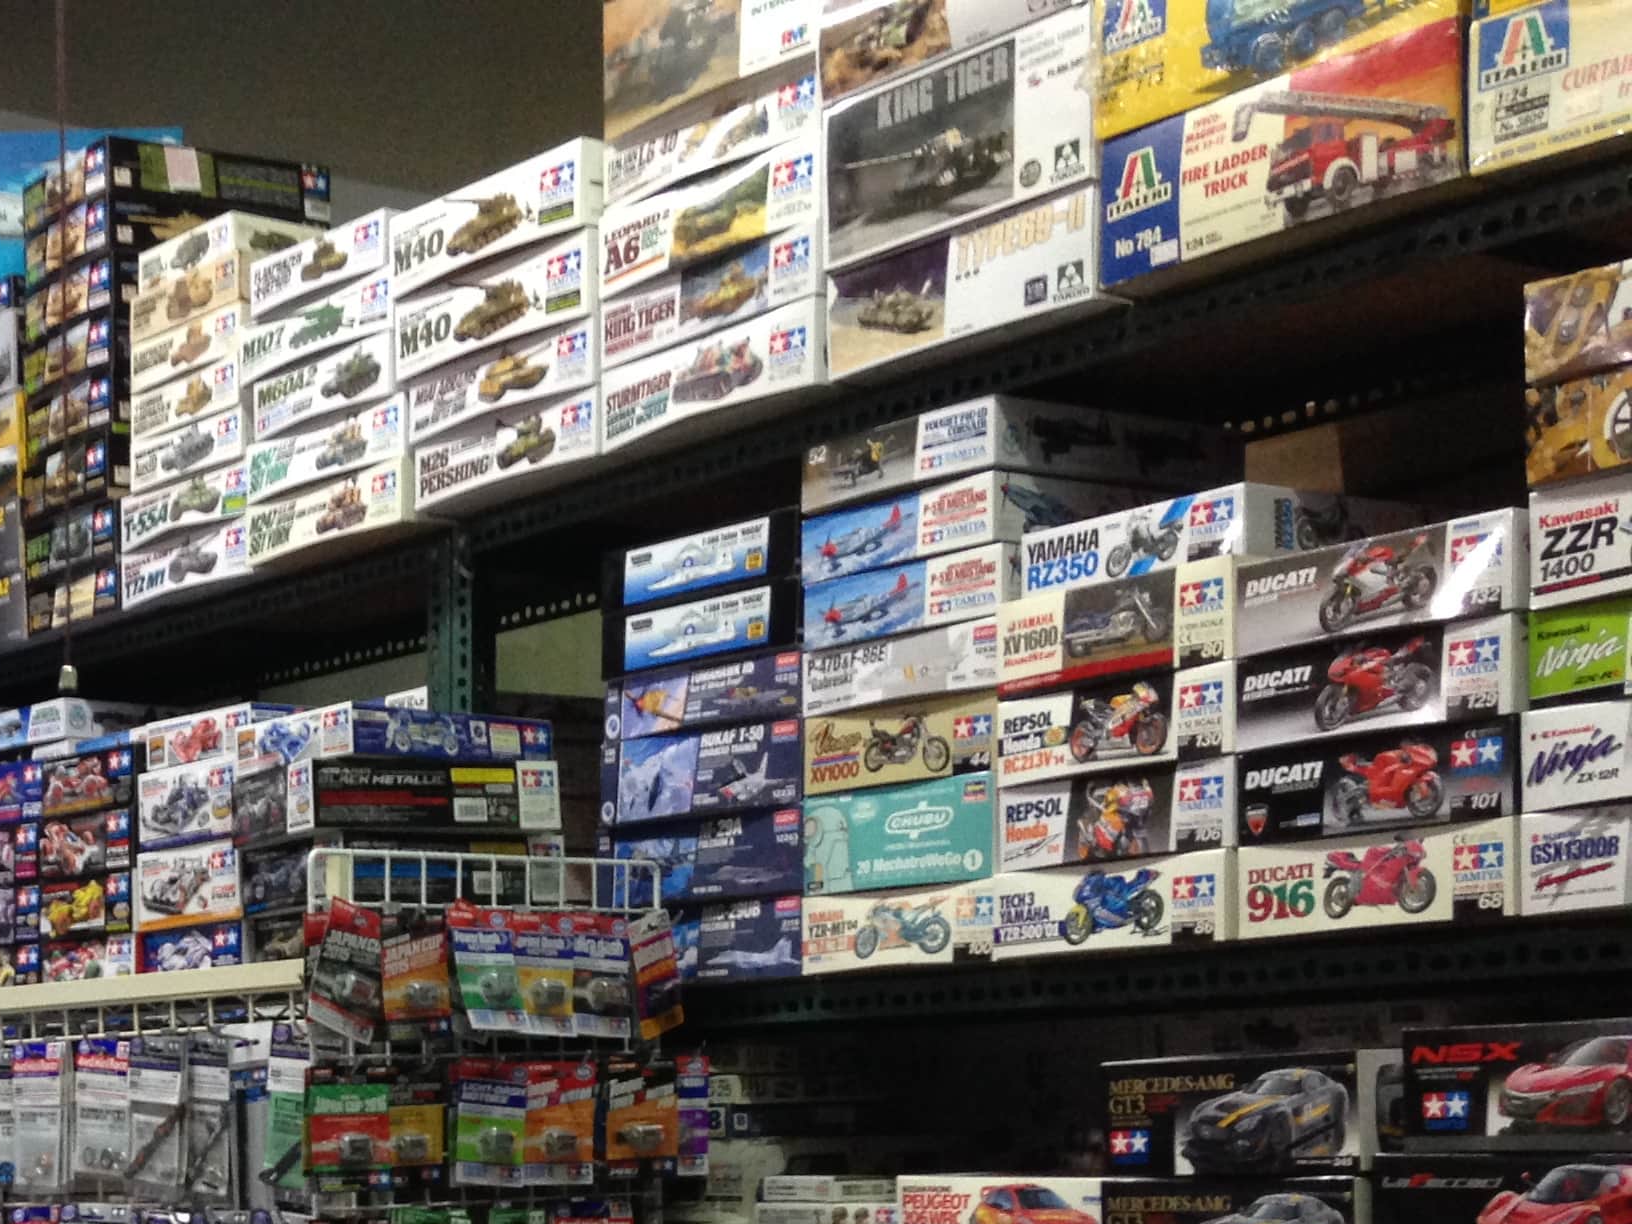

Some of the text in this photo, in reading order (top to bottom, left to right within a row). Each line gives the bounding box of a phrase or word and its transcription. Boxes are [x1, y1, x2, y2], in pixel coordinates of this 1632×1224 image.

[1485, 53, 1562, 84] ITALERI
[877, 46, 1009, 130] KING TIGER
[1182, 144, 1268, 186] FIRE LADDER
[1203, 172, 1248, 199] TRUCK
[1108, 186, 1169, 220] ITALERI
[603, 211, 661, 245] LEOPARD
[394, 228, 444, 277] M40
[605, 232, 641, 276] A6
[605, 299, 676, 344] KING TIGER
[400, 312, 451, 360] M40
[606, 370, 672, 415] STURMTIGER
[420, 449, 449, 474] M26
[808, 446, 827, 465] 52
[946, 444, 986, 465] TAMIYA
[420, 454, 489, 498] PERSHING
[1538, 501, 1620, 529] Kawasaki
[946, 520, 987, 535] TAMIYA
[1539, 515, 1619, 561] ZZR
[1027, 528, 1099, 562] YAMAHA
[1028, 551, 1099, 591] RZ350
[1539, 552, 1595, 582] 1400
[1245, 567, 1317, 597] DUCATI
[954, 592, 996, 609] TAMIYA
[1183, 604, 1223, 616] TAMIYA
[1018, 614, 1054, 630] YAMAHA
[1537, 623, 1591, 642] Kawasaki
[1003, 626, 1058, 656] XV1600
[1535, 631, 1627, 679] Ninja
[1243, 665, 1312, 693] DUCATI
[1449, 662, 1498, 677] TAMIYA
[1003, 711, 1053, 735] REPSOL
[972, 752, 990, 766] 44
[1003, 755, 1053, 774] RC213V
[1526, 729, 1623, 788] Ninja
[372, 771, 445, 785] METALLIC
[811, 763, 860, 784] XV1000
[1244, 761, 1324, 791] DUCATI
[1577, 768, 1620, 784] ZX-12R
[1006, 798, 1063, 823] REPSOL
[1178, 800, 1222, 812] TAMIYA
[1469, 793, 1498, 809] 101
[891, 811, 946, 830] CHUBU
[1006, 823, 1048, 842] Honda
[1194, 828, 1220, 841] 106
[1247, 862, 1315, 884] DUCATI
[1453, 868, 1504, 882] TAMIYA
[1000, 894, 1024, 909] TECH
[1173, 899, 1214, 909] TAMIYA
[1246, 879, 1315, 923] 916
[1477, 894, 1502, 909] 68
[1000, 907, 1050, 924] YAMAHA
[1411, 1042, 1522, 1064] NSX
[1109, 1074, 1235, 1096] MERCEDES-AMG
[1109, 1097, 1146, 1115] GT3
[902, 1193, 971, 1210] PEUGEOT
[1107, 1195, 1231, 1214] MERCEDES-AMG
